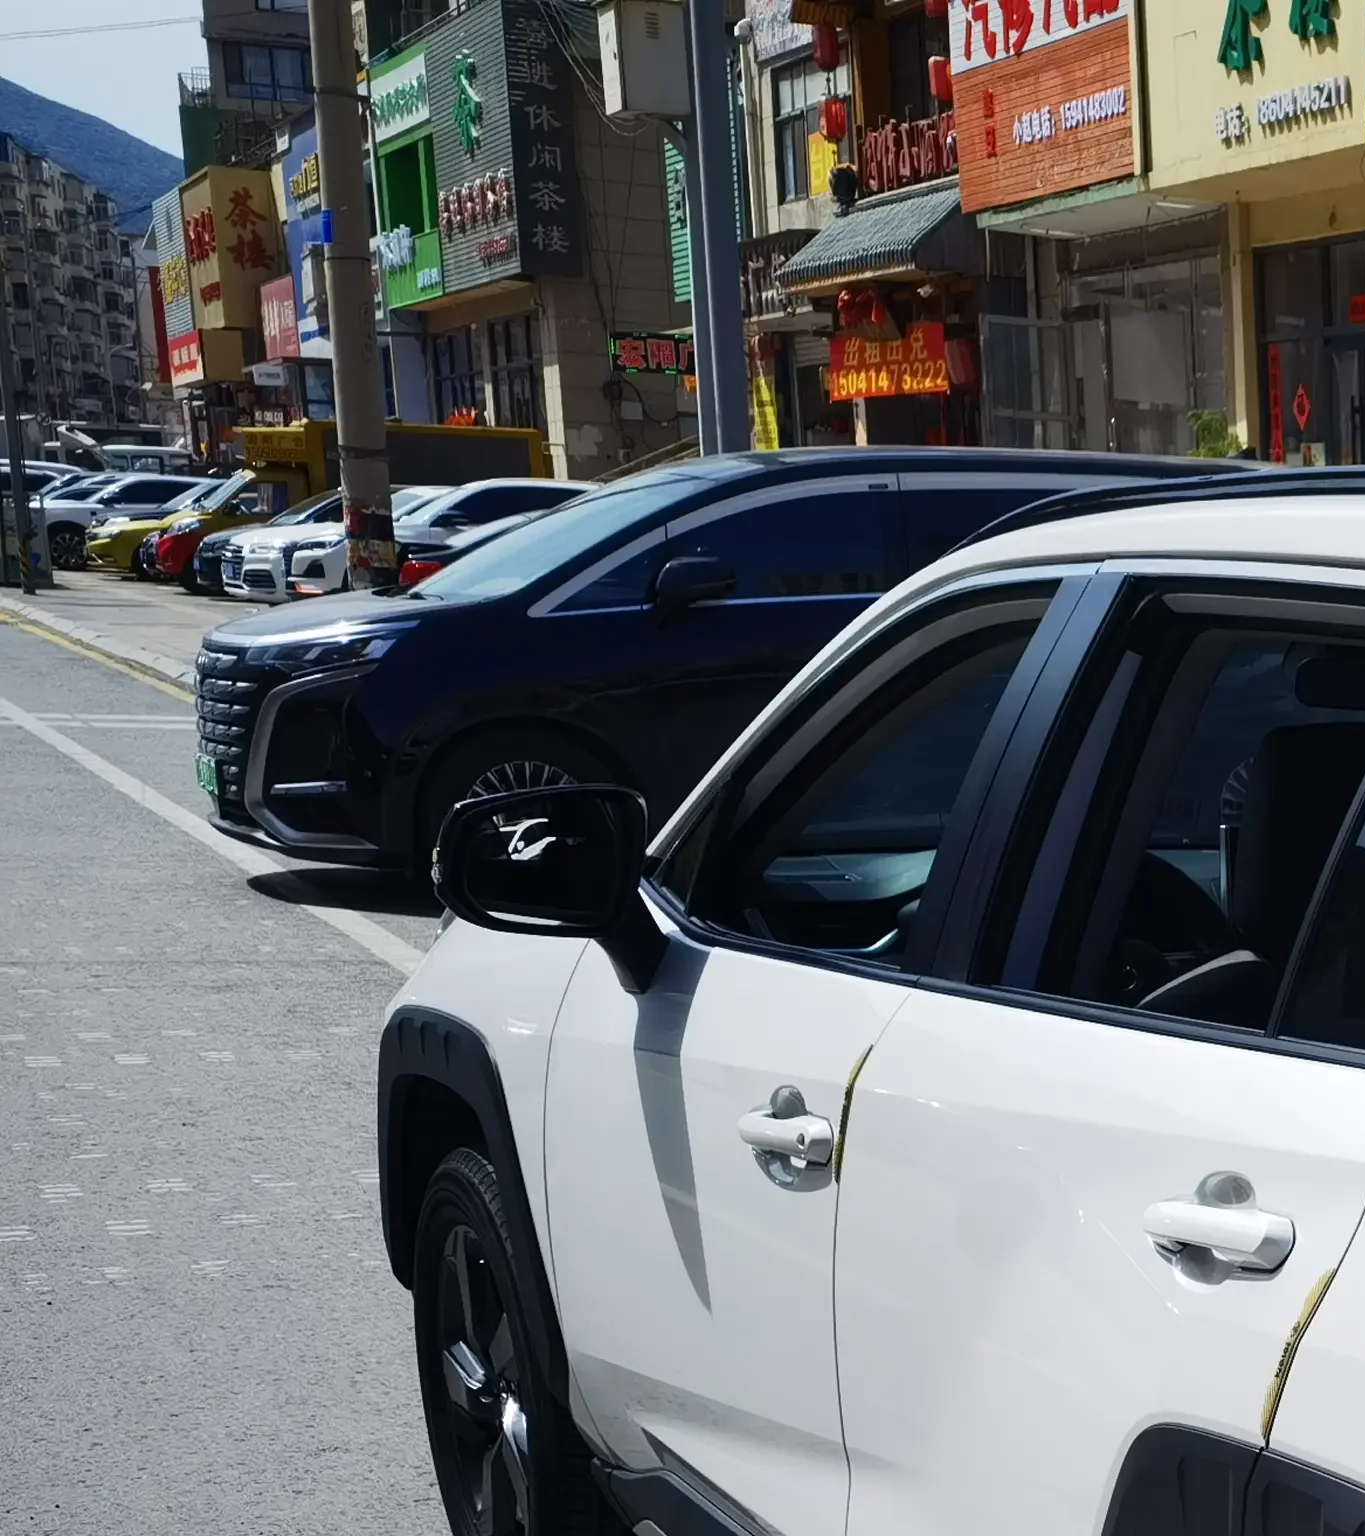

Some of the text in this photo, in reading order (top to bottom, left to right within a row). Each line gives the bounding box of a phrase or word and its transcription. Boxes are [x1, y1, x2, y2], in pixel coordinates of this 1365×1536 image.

[1059, 85, 1127, 131] 15941483002
[1256, 76, 1349, 125] 18604145211
[223, 186, 275, 271] 茶楼
[832, 360, 948, 397] 15041473222
